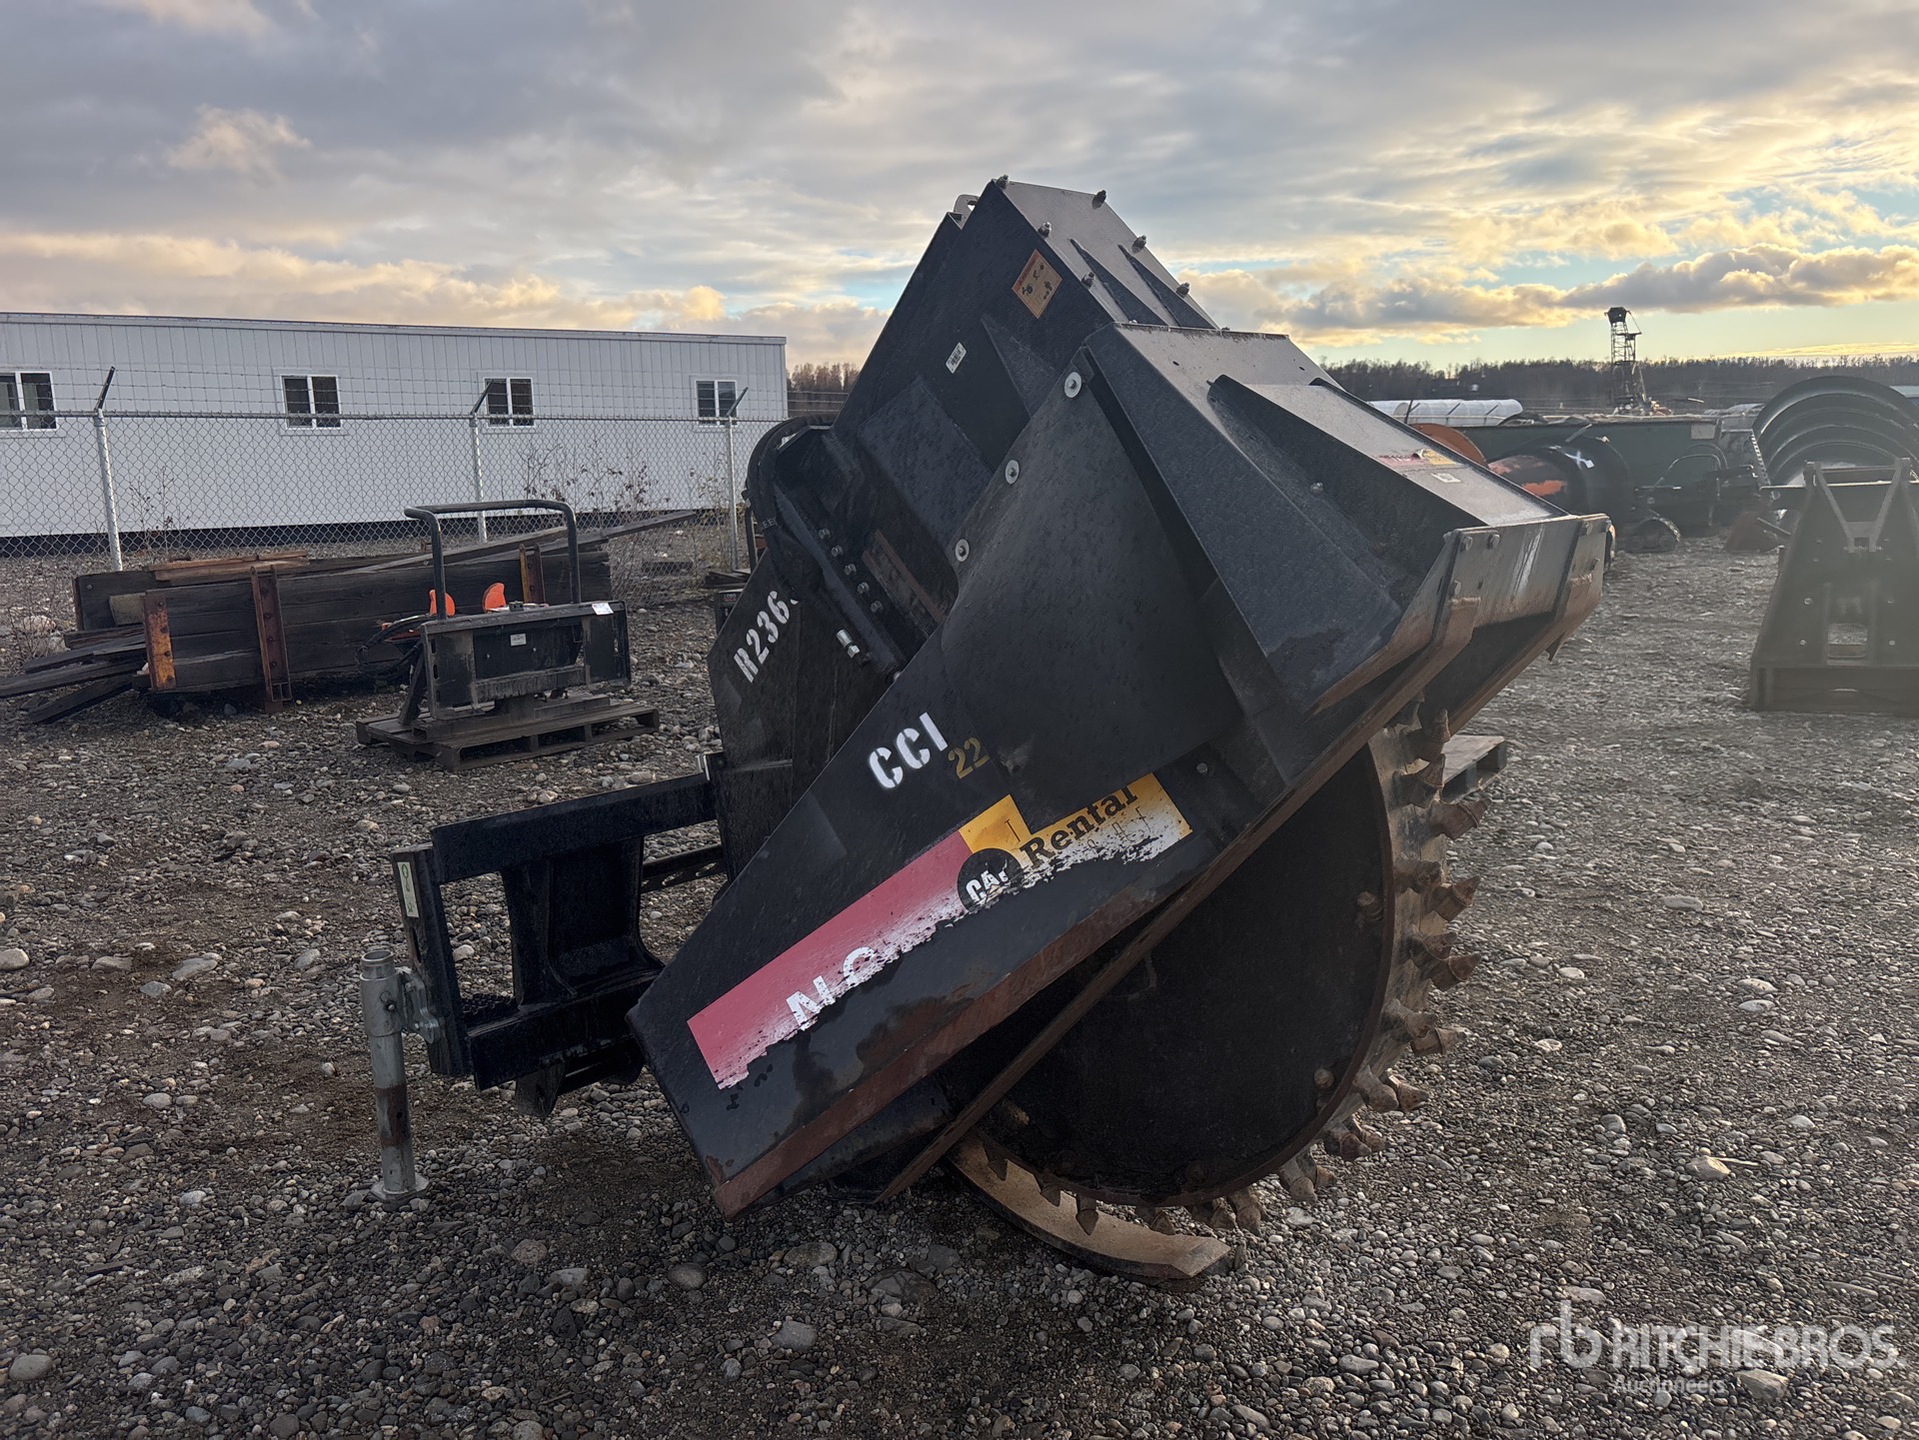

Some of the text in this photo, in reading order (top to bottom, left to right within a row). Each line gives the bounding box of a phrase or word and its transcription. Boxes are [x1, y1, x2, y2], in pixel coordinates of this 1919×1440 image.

[869, 712, 948, 789] CCI
[948, 737, 990, 779] 22
[1019, 786, 1138, 867] Rental
